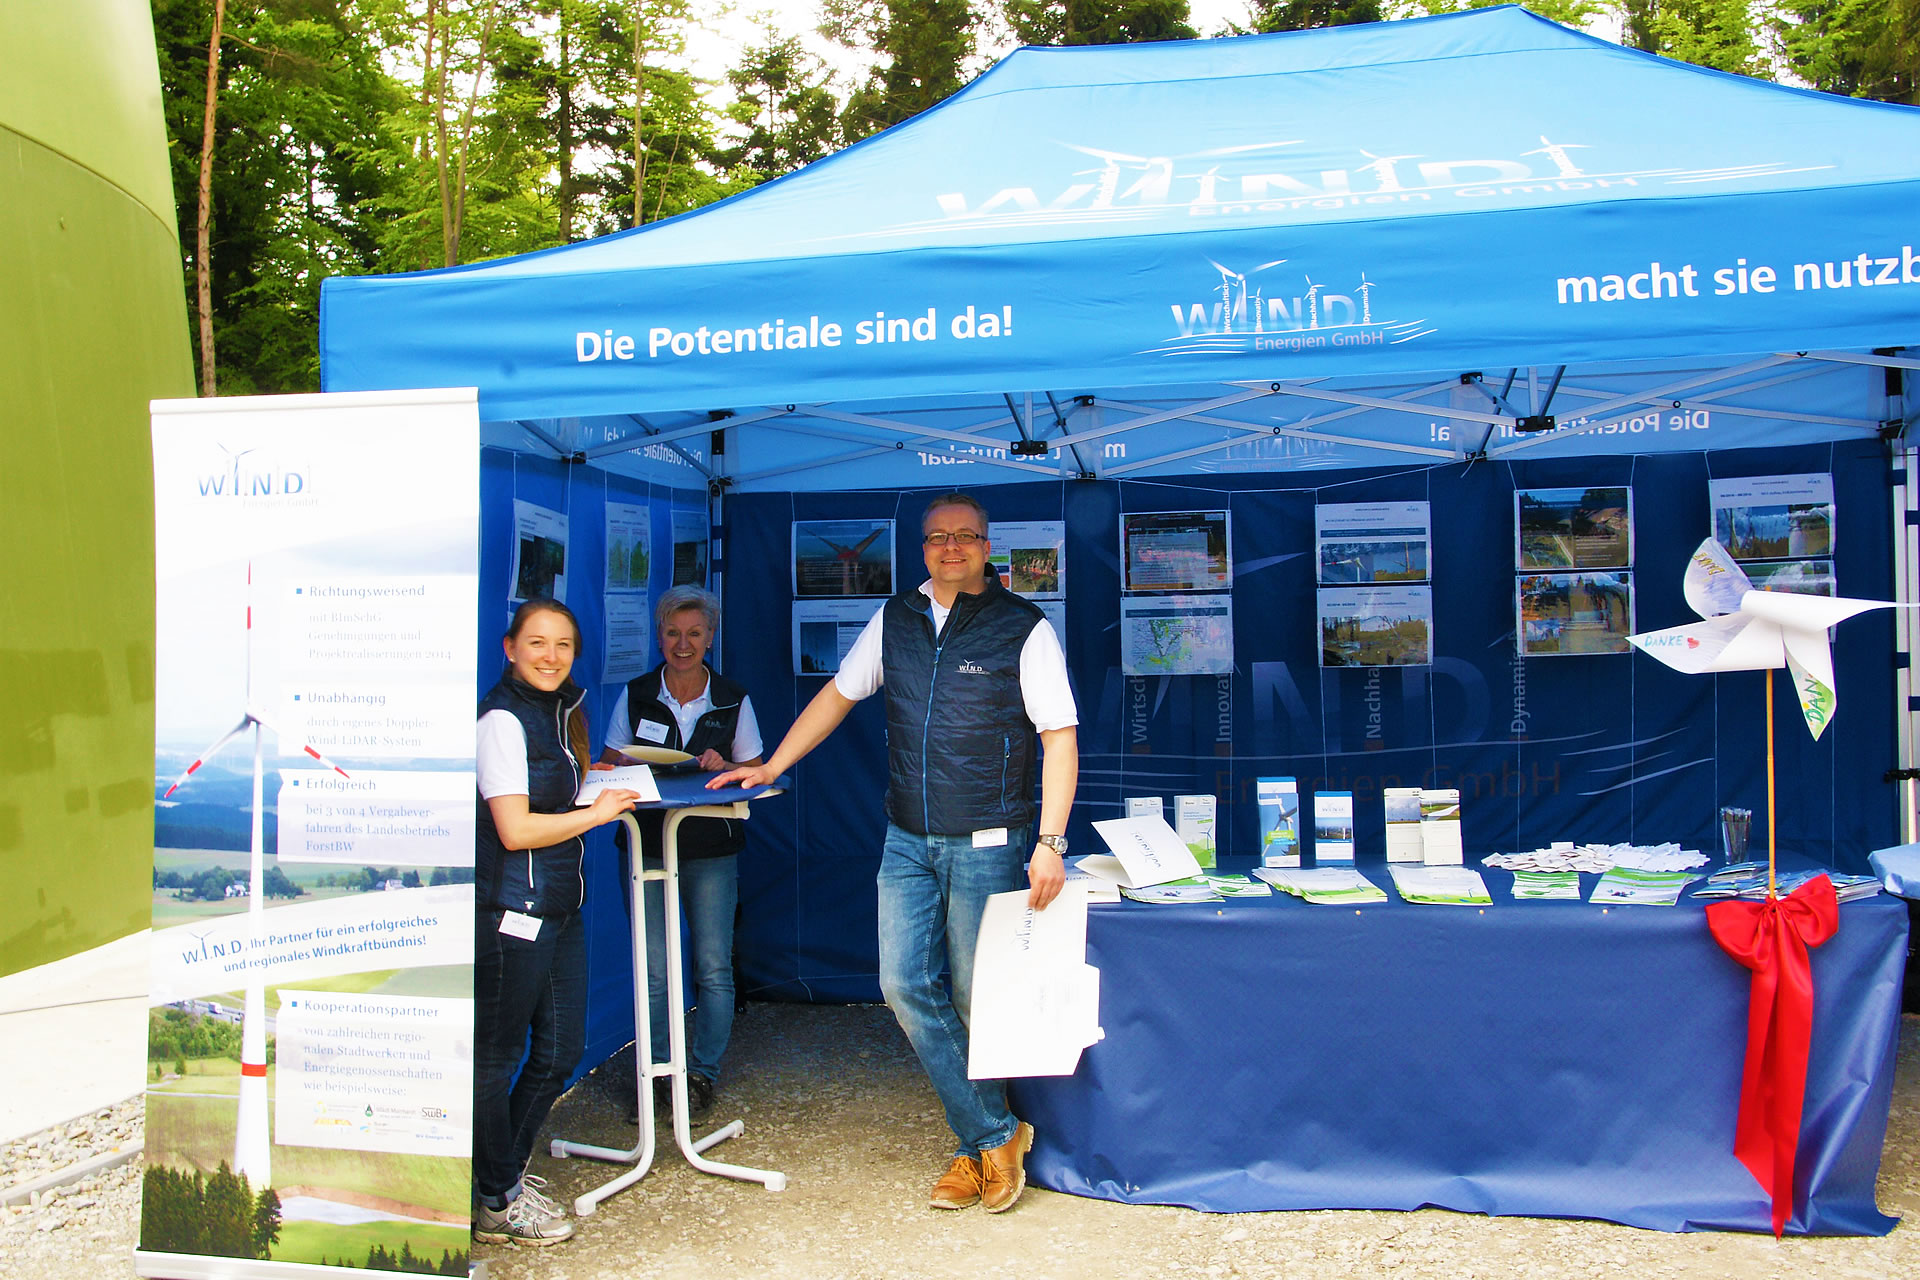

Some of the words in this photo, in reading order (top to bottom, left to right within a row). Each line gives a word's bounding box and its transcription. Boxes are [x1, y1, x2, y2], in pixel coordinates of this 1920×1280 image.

[1454, 176, 1640, 199] GmbH
[1557, 262, 1699, 304] macht
[1713, 258, 1777, 296] sie
[1794, 245, 1920, 291] nutzb
[575, 328, 635, 362] Die
[648, 315, 843, 358] Potentiale
[855, 309, 937, 346] sind
[950, 305, 1013, 340] da!
[1255, 335, 1326, 352] Energien
[1332, 330, 1384, 347] GmbH
[309, 584, 425, 599] Richtungsweisend
[309, 611, 328, 623] mit
[308, 630, 396, 643] Genehmigungen
[400, 630, 422, 641] und
[1644, 635, 1683, 648] DANKE
[308, 648, 422, 662] Projektrealisierungen
[425, 651, 452, 661] 2014
[306, 716, 339, 728] durch
[342, 717, 382, 730] eigenes
[306, 777, 376, 793] Erfolgreich
[1215, 766, 1403, 807] Enrgien
[306, 803, 322, 816] bei
[325, 806, 333, 817] 3
[336, 806, 355, 817] von
[359, 807, 365, 817] 4
[368, 805, 435, 819] Vergabever-
[305, 822, 342, 834] fahren
[344, 822, 363, 834] des
[366, 823, 451, 838] Landesbetriebs
[305, 840, 355, 852] ForstBW
[251, 937, 266, 949] Ihr
[269, 931, 313, 947] Partner
[316, 926, 334, 939] für
[337, 923, 355, 936] ein
[358, 915, 438, 934] erfolgreiches
[223, 958, 246, 973] und
[249, 948, 311, 970] regionales
[312, 935, 427, 959] Windkraftbündnis!
[304, 999, 440, 1018] Kooperationspartner
[303, 1027, 324, 1038] von
[327, 1025, 391, 1041] zahlreichen
[393, 1031, 426, 1043] regio-
[303, 1045, 334, 1056] nalen
[337, 1046, 406, 1060] Stadtwerken
[409, 1049, 431, 1062] und
[303, 1061, 443, 1081] Energiegenossenschaften
[303, 1080, 322, 1091] wie
[325, 1080, 407, 1097] beispielsweise:
